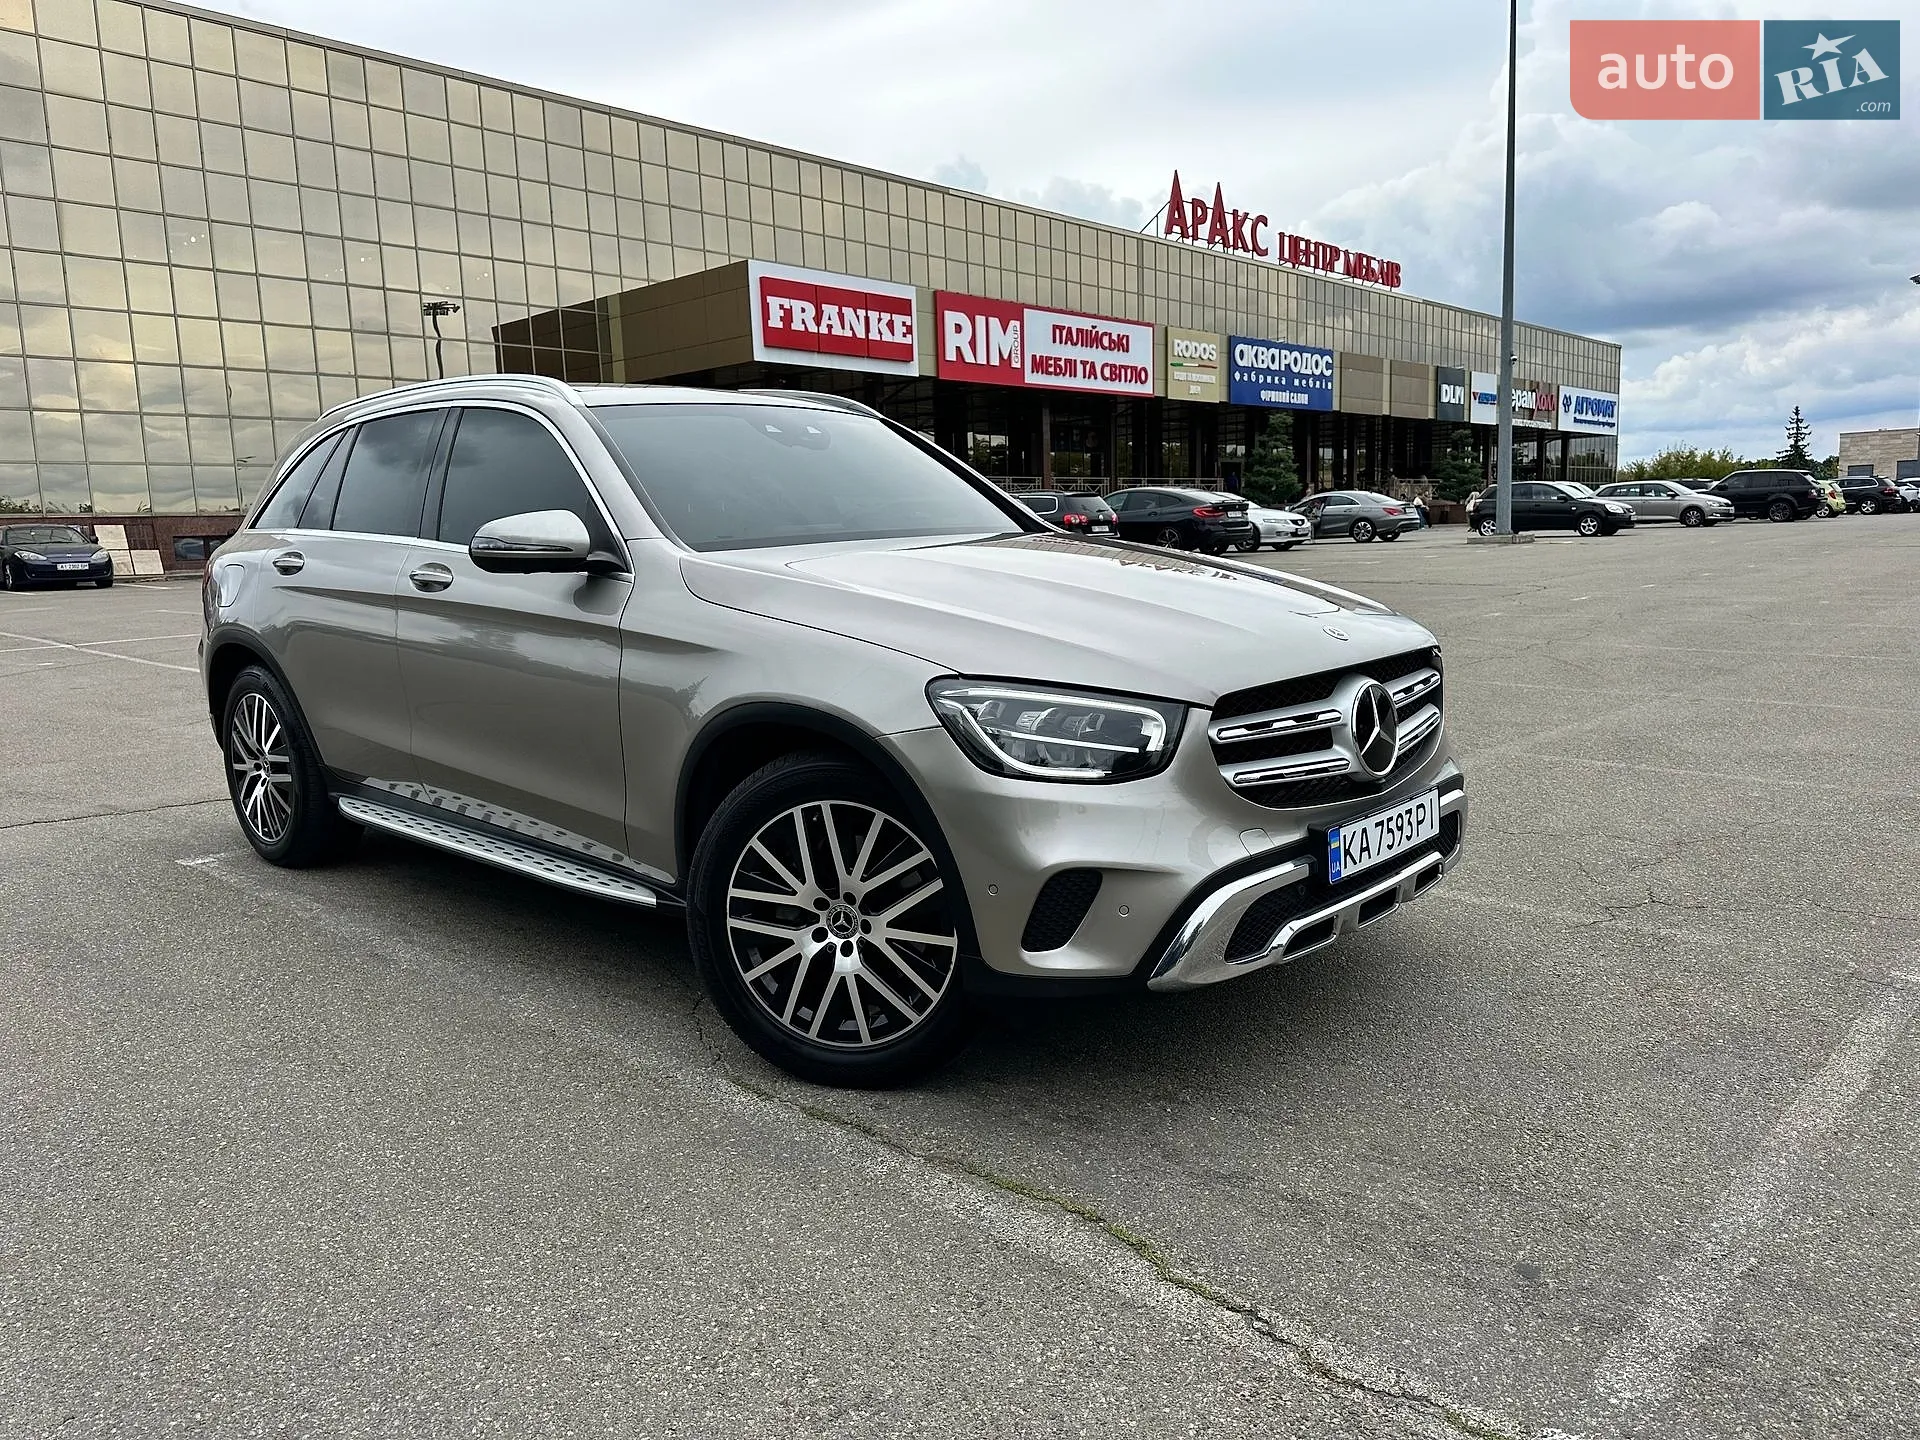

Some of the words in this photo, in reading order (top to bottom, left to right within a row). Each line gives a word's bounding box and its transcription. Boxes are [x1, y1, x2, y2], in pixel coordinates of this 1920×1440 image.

[1164, 169, 1268, 257] АРАКС
[1278, 232, 1340, 273] ЦЕНТР
[766, 295, 913, 345] FRANKE
[944, 310, 1021, 369] RIM
[1052, 324, 1130, 353] ІТАЛІЙСЬКІ
[1173, 339, 1217, 361] RODOS
[1031, 354, 1077, 378] МЕБЛІ
[1080, 360, 1098, 380] ТА
[1100, 362, 1149, 385] СВІТЛО
[1573, 395, 1617, 419] АГРОМАТ
[1343, 826, 1372, 869] KA
[1374, 808, 1413, 857] 7593
[1331, 861, 1340, 873] UA
